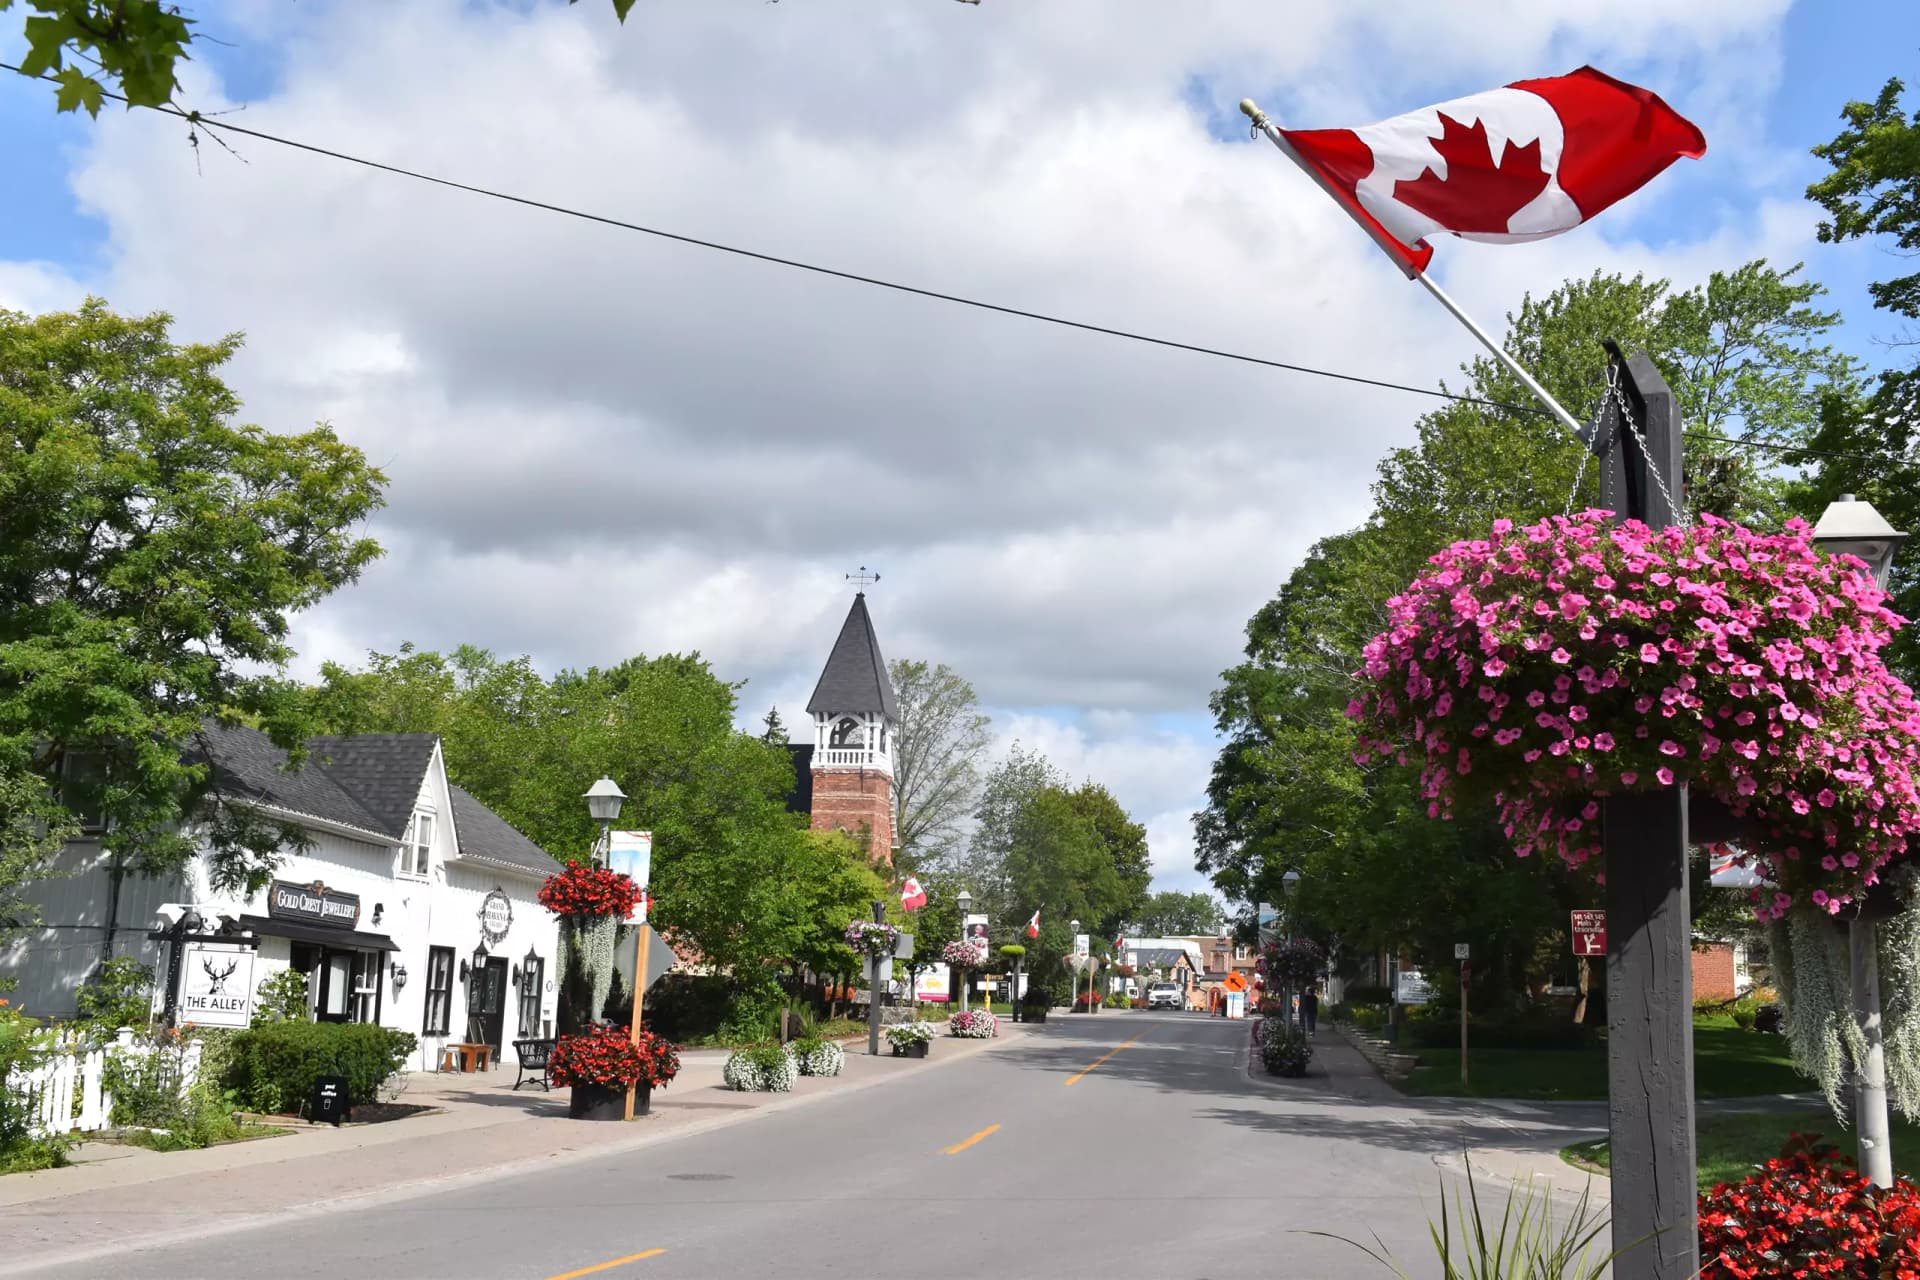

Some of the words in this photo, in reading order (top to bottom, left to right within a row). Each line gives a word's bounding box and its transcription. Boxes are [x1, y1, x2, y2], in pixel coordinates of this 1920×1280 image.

[277, 890, 299, 909] GOLD
[299, 894, 322, 913] CREST
[320, 898, 356, 918] JEWELLERY
[187, 996, 207, 1008] THE
[210, 998, 246, 1010] ALLEY
